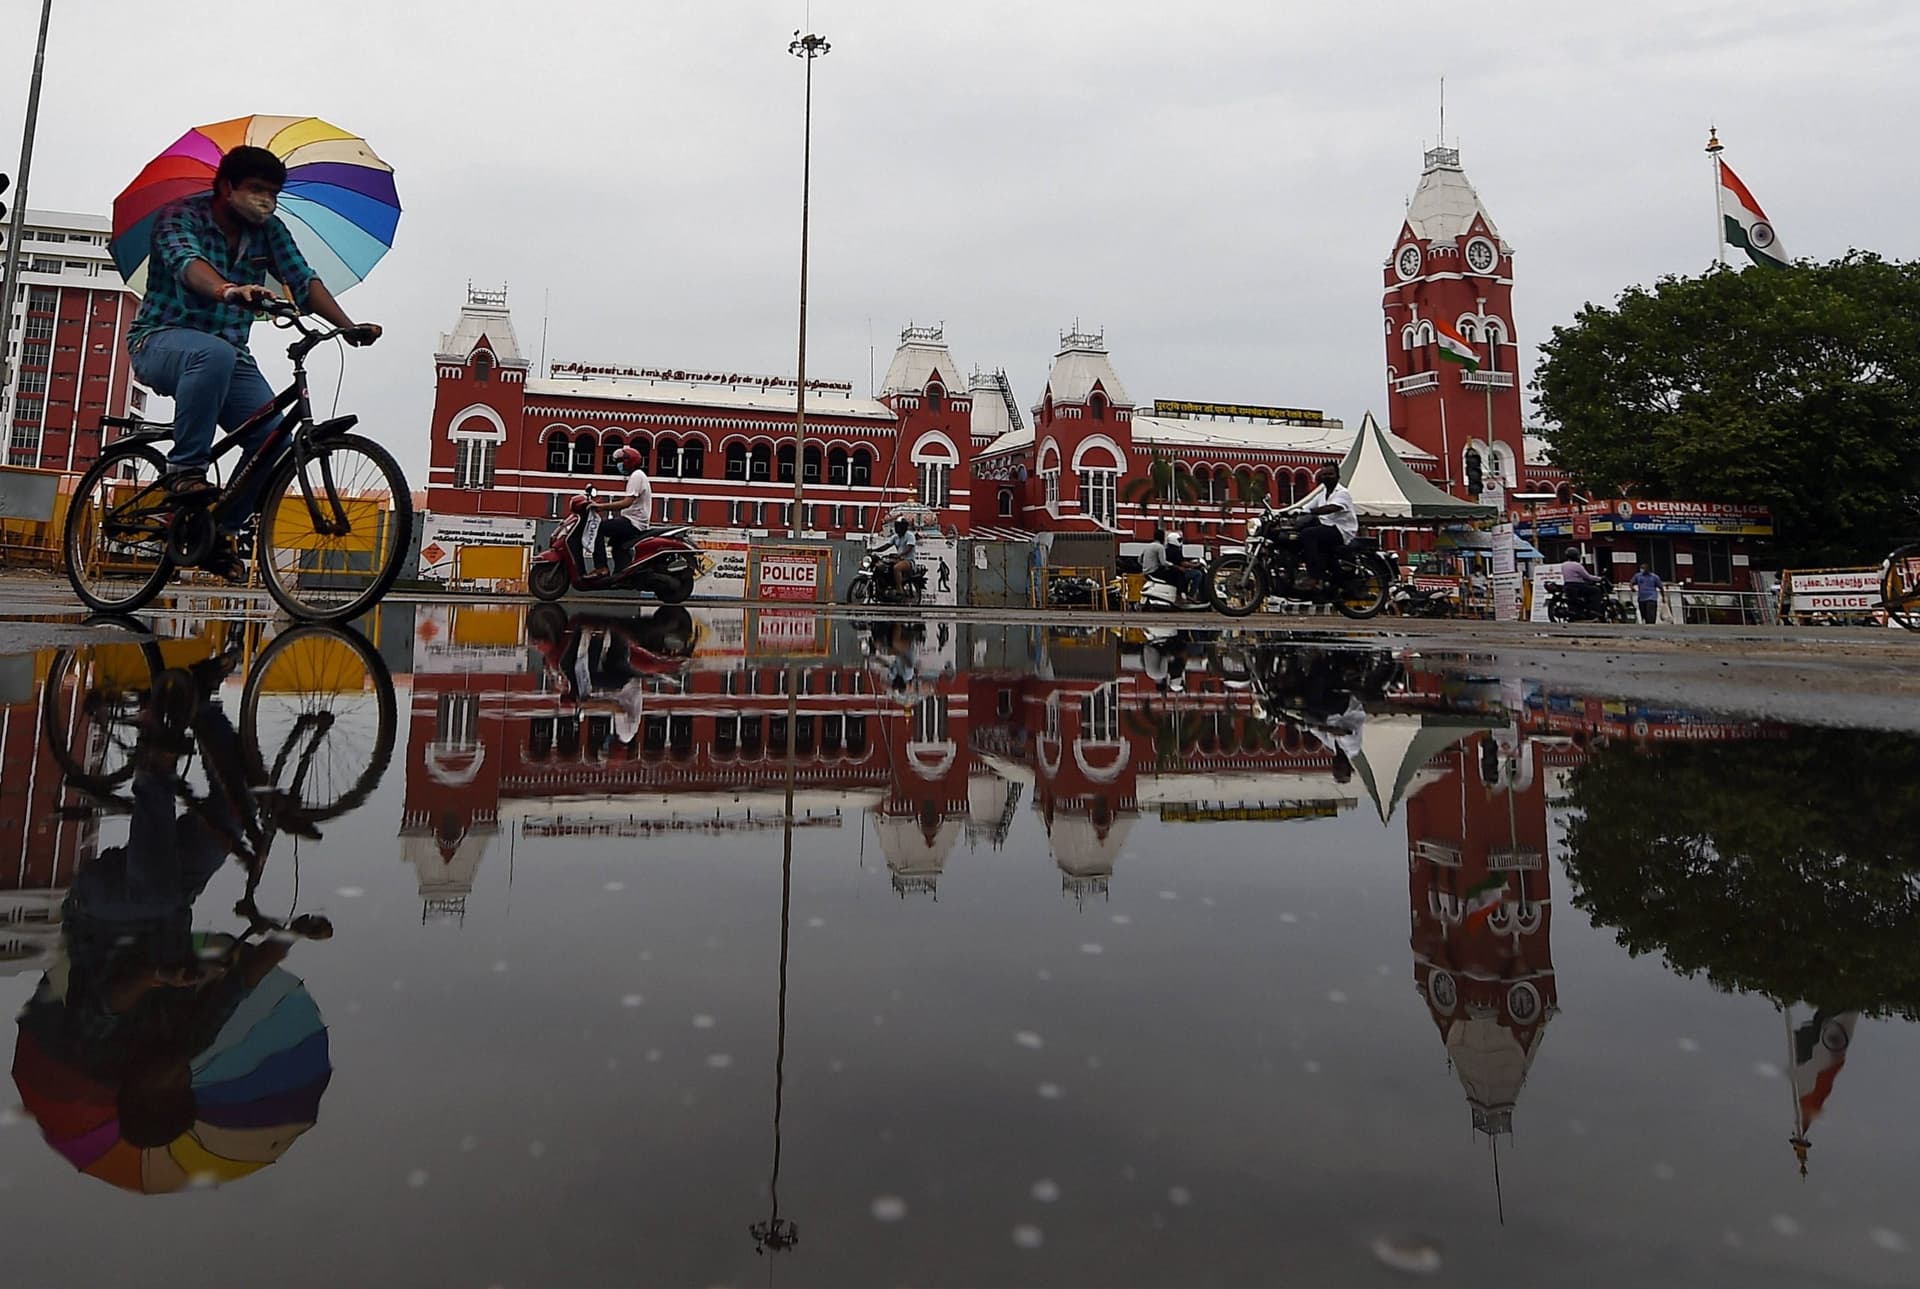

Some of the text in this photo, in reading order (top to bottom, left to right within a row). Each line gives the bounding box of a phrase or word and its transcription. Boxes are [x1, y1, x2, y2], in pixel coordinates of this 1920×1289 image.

[1636, 501, 1769, 514] CHENNAI POLICE
[1633, 522, 1666, 531] ORBIT
[762, 566, 814, 581] POLICE
[1812, 597, 1868, 607] POLICE
